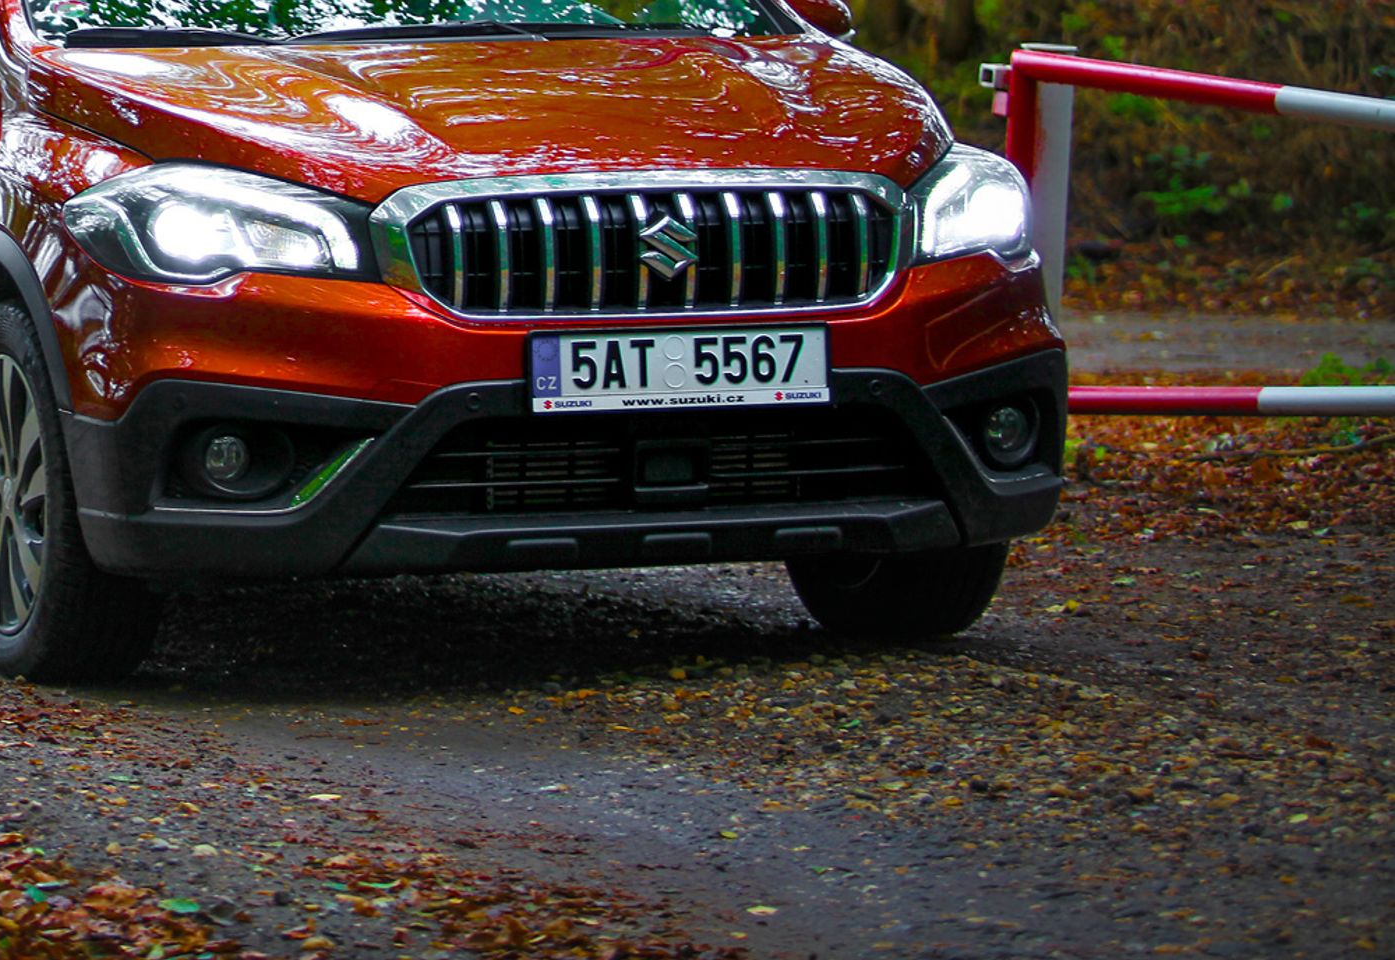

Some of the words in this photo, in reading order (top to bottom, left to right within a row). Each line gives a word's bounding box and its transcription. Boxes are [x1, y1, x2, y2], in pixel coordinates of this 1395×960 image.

[570, 338, 655, 390] 5AT
[693, 333, 805, 385] 5567
[535, 376, 557, 391] CZ
[621, 394, 745, 406] www.suzuki.cz
[784, 390, 822, 400] SUZUKI
[554, 399, 593, 409] SUZUKI
